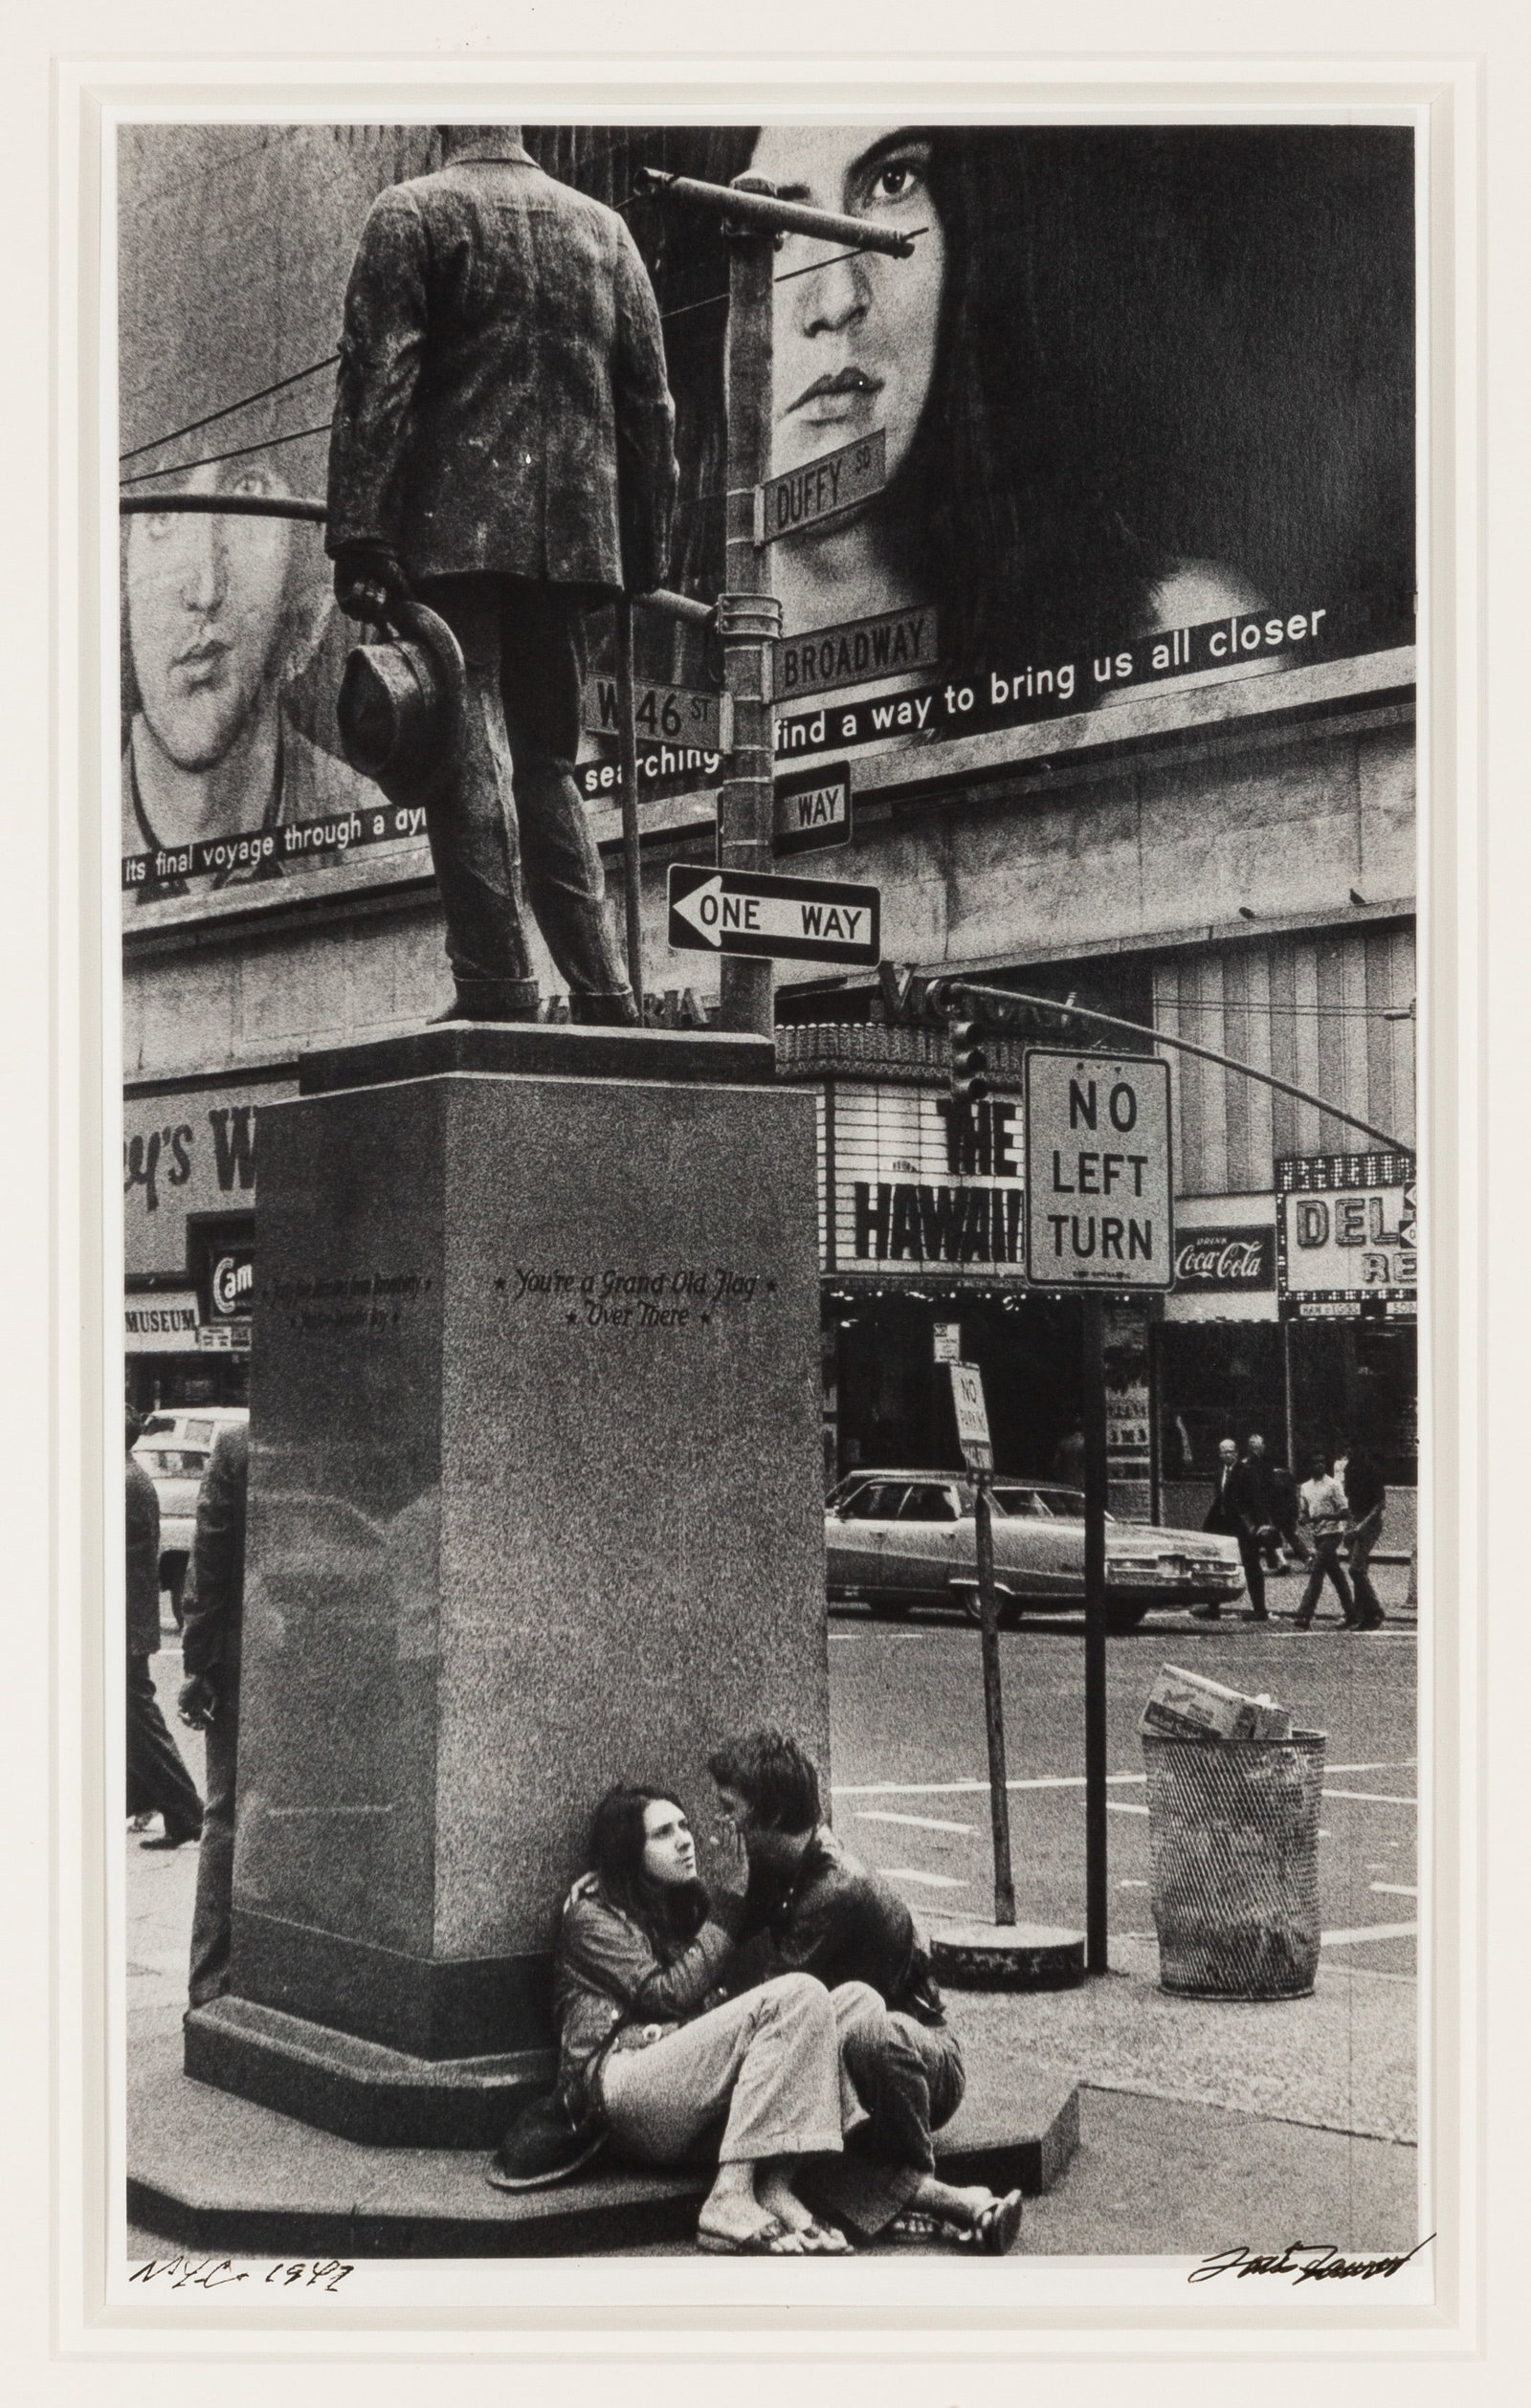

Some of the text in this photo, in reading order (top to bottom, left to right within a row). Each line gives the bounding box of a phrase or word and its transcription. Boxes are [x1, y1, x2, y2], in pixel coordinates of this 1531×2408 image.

[776, 457, 842, 525] DUFFY
[784, 617, 924, 688] BROADWAY
[775, 705, 826, 752] find
[841, 712, 857, 737] a
[872, 695, 932, 739] way
[943, 683, 974, 715] to
[990, 664, 1076, 705] bring
[1093, 652, 1133, 682] us
[1151, 629, 1190, 671] all
[1209, 608, 1327, 655] closer
[634, 689, 682, 738] 46
[691, 696, 712, 720] ST
[797, 788, 839, 828] WAY
[155, 844, 193, 876] final
[203, 836, 275, 870] voyage
[283, 812, 362, 851] through
[372, 814, 385, 836] a
[699, 894, 863, 940] ONE WAY
[1068, 1078, 1138, 1133] NO
[936, 1098, 1019, 1177] THE
[1053, 1150, 1148, 1198] LEFT
[1047, 1214, 1153, 1261] TURN
[581, 1273, 594, 1292] a
[598, 1270, 666, 1299] Grand
[671, 1270, 706, 1294] Old
[124, 1309, 196, 1333] MUSEUM
[585, 1299, 690, 1328] Over There
